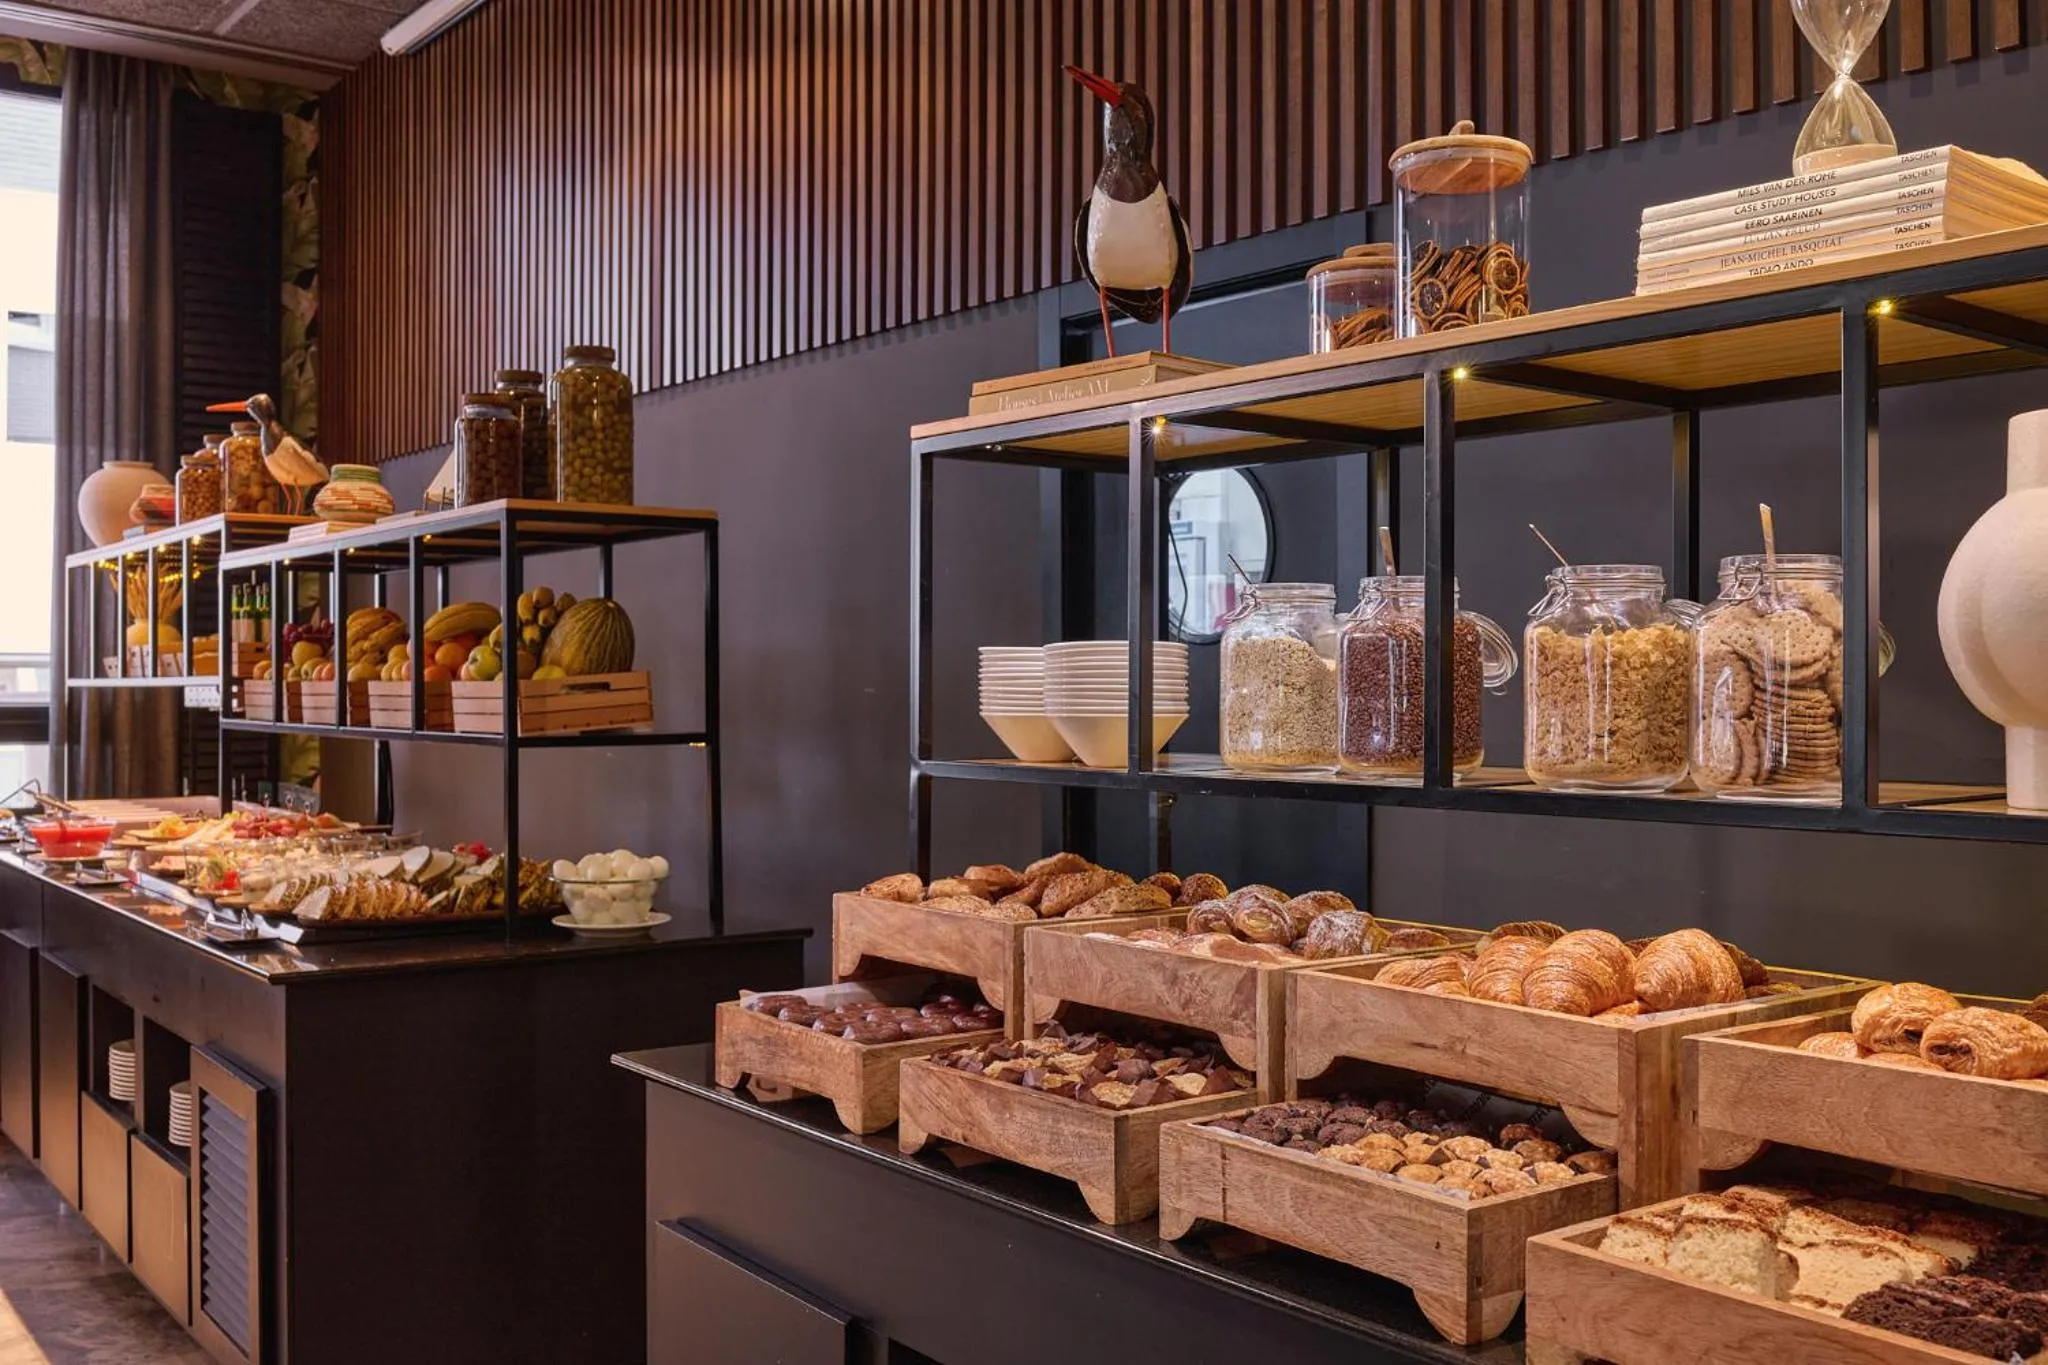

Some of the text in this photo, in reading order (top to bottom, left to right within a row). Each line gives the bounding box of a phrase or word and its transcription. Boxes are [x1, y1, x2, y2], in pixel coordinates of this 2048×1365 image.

[1734, 168, 1935, 215] CASE STUDY HOUSES TASCHEN
[1763, 182, 1783, 193] VAN
[1785, 177, 1805, 188] DER
[1808, 171, 1838, 183] ROHE
[1900, 151, 1937, 164] TASCHEN
[1745, 186, 1934, 230] EERO SAARINEN TASCHEN
[1896, 202, 1933, 215] TASCHEN
[1721, 221, 1932, 269] JEAN-MICHEL BASQUIAT TASCHEN
[1748, 264, 1781, 276] TADAO
[1783, 258, 1814, 270] ANDO
